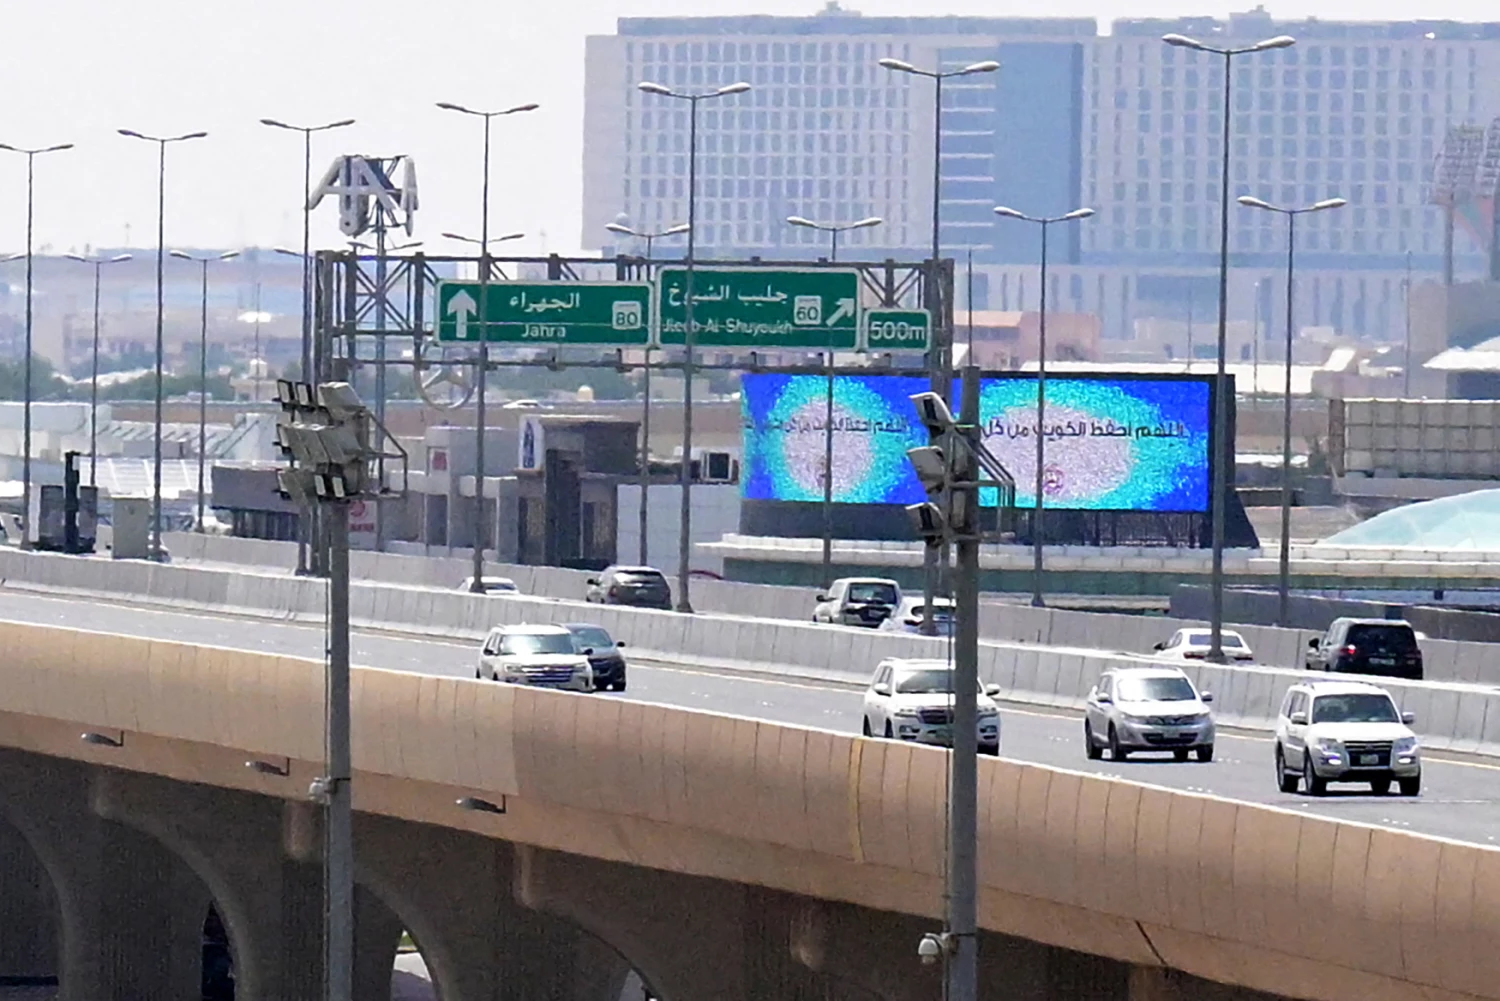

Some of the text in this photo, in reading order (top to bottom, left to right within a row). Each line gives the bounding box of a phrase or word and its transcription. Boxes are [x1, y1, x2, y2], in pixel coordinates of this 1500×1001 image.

[509, 291, 581, 314] الجهراء
[737, 284, 788, 307] جليب
[615, 311, 639, 326] 80
[796, 306, 819, 321] 60
[520, 324, 567, 338] Jahra
[869, 321, 926, 341] 500m
